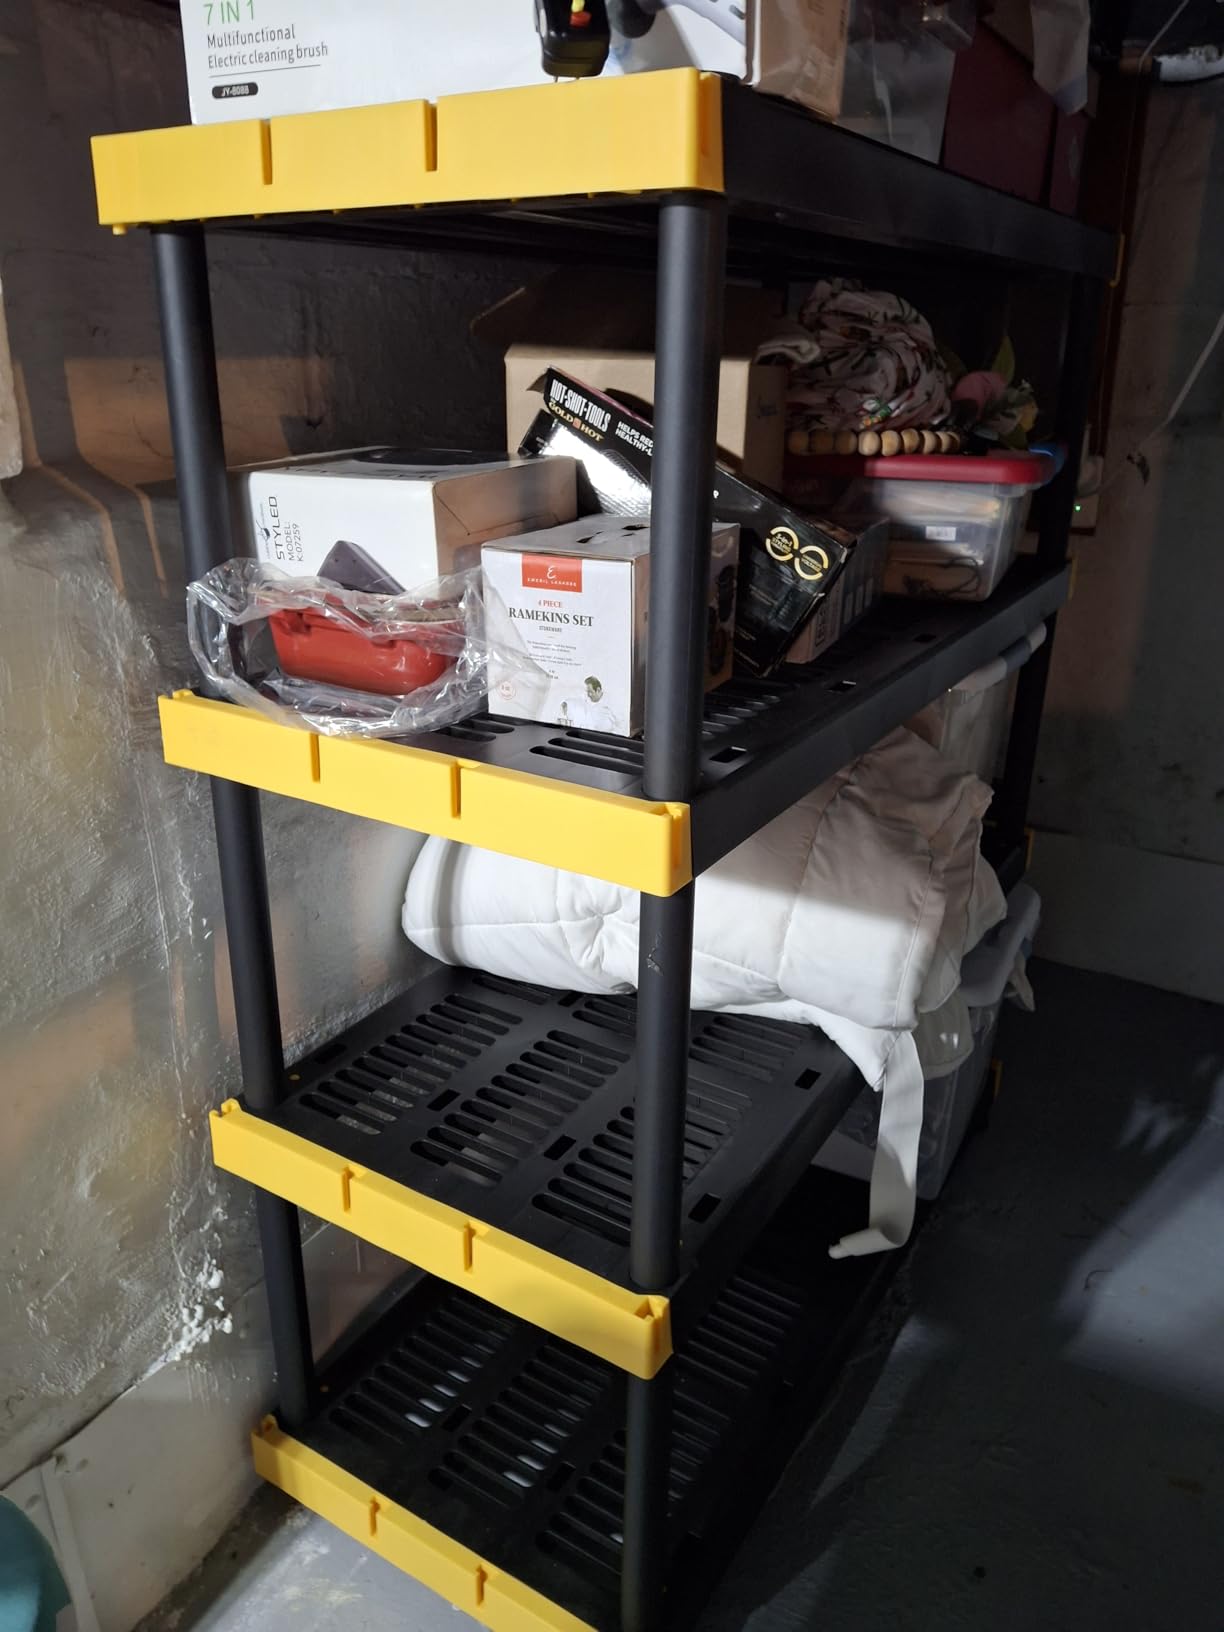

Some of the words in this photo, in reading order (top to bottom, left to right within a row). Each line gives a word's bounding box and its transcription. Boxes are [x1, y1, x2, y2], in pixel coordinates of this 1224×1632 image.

[203, 3, 213, 26] 7
[220, 0, 240, 24] IN
[247, 0, 255, 20] 1
[207, 23, 296, 48] Multifunctional
[208, 51, 247, 69] Electric
[249, 46, 294, 64] cleaning
[296, 41, 328, 59] brush
[548, 402, 574, 423] GOLD
[580, 424, 604, 442] HOT
[617, 421, 640, 439] HELPS
[269, 496, 286, 560] STYLED
[543, 599, 563, 608] PIECE
[508, 607, 570, 625] RAMEKINS
[572, 614, 595, 627] SET
